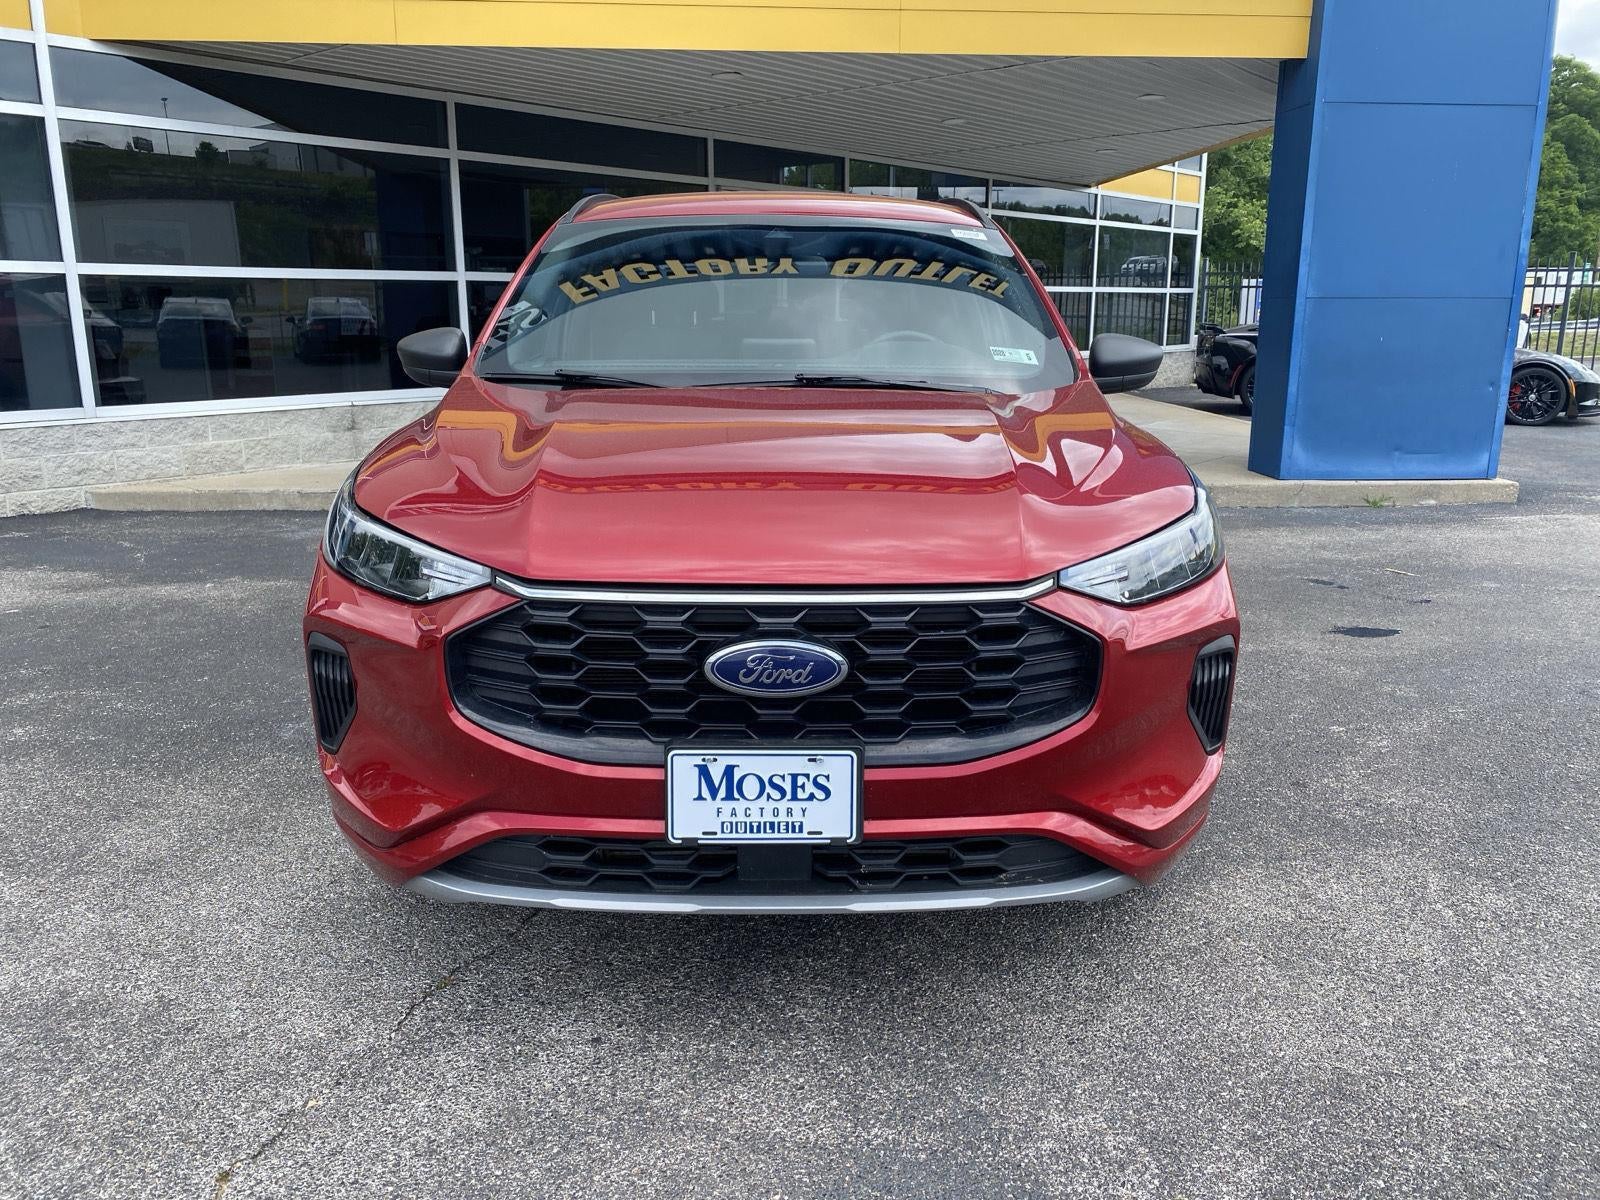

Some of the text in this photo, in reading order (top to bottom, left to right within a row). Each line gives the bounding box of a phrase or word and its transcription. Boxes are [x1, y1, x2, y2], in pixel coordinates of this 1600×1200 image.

[738, 653, 814, 684] Ford
[692, 763, 832, 802] MOSES
[716, 807, 808, 818] FACTORY
[722, 821, 803, 834] OUTLET
